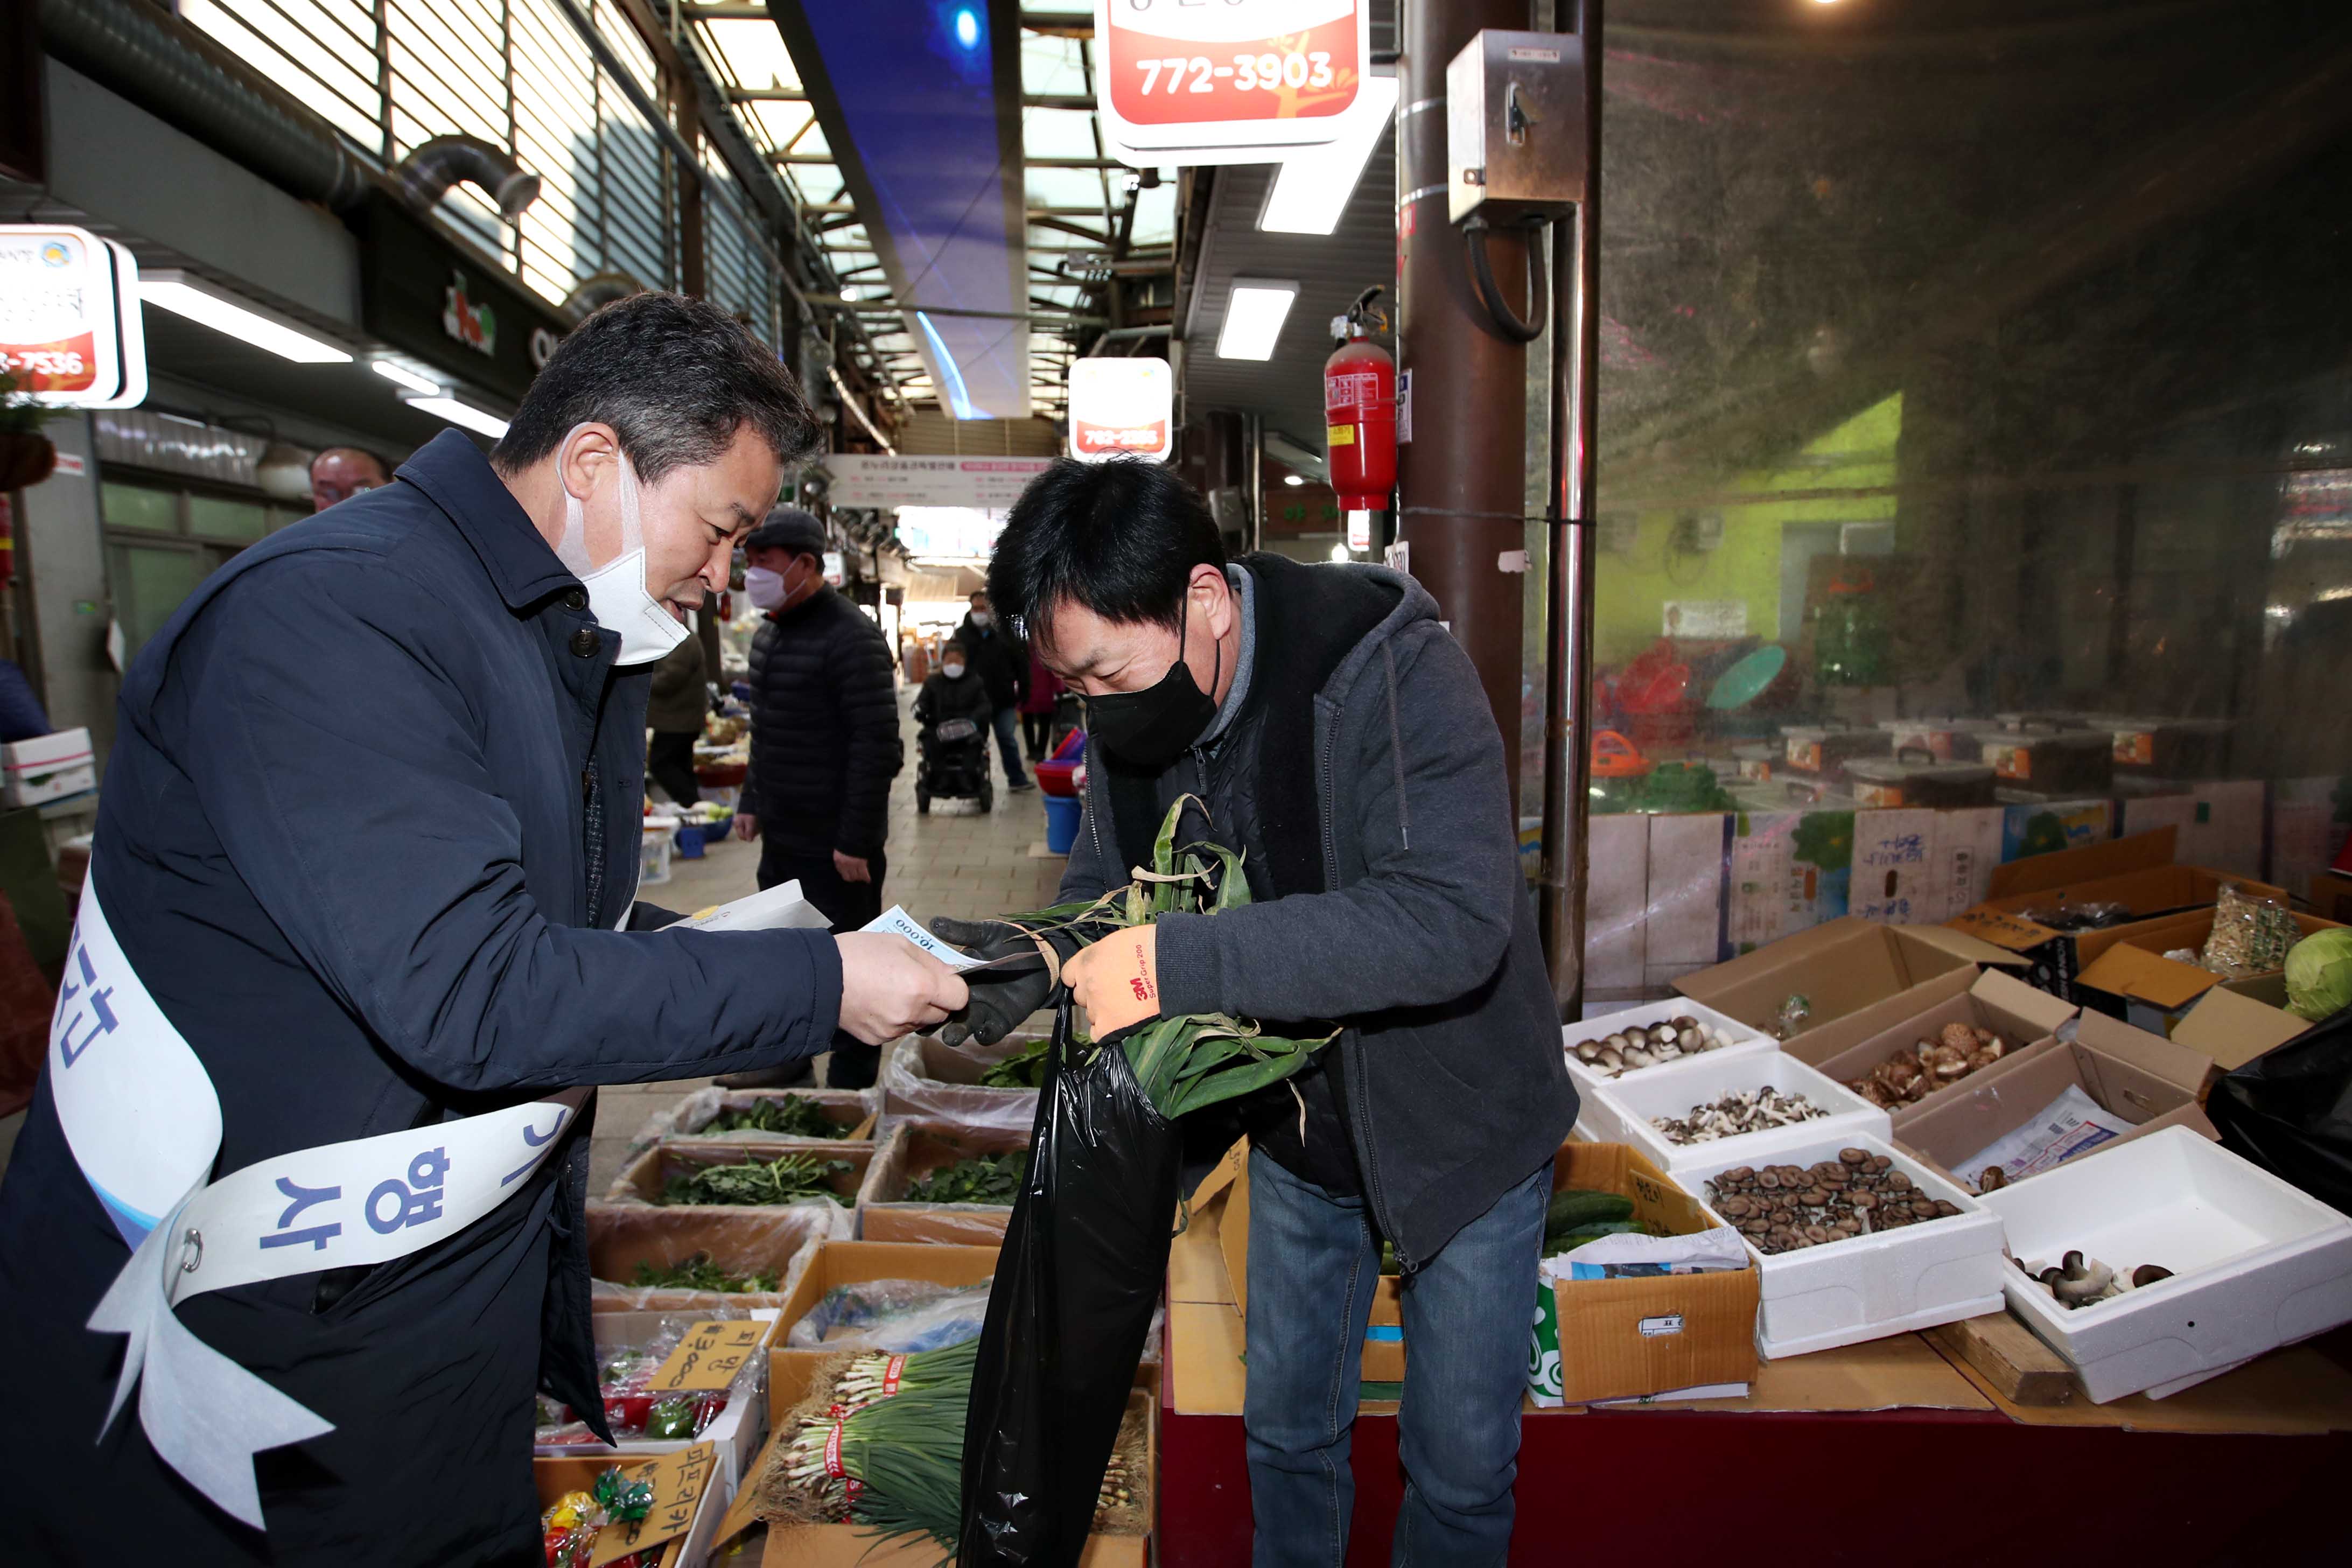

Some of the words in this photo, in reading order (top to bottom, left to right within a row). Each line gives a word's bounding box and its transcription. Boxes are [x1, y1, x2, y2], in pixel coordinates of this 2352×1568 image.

[1136, 51, 1333, 96] 772-3903
[1130, 977, 1148, 1001] 3M
[1144, 977, 1156, 998] Super
[260, 1146, 451, 1251] 행사
[661, 1448, 709, 1532] 파프리카
